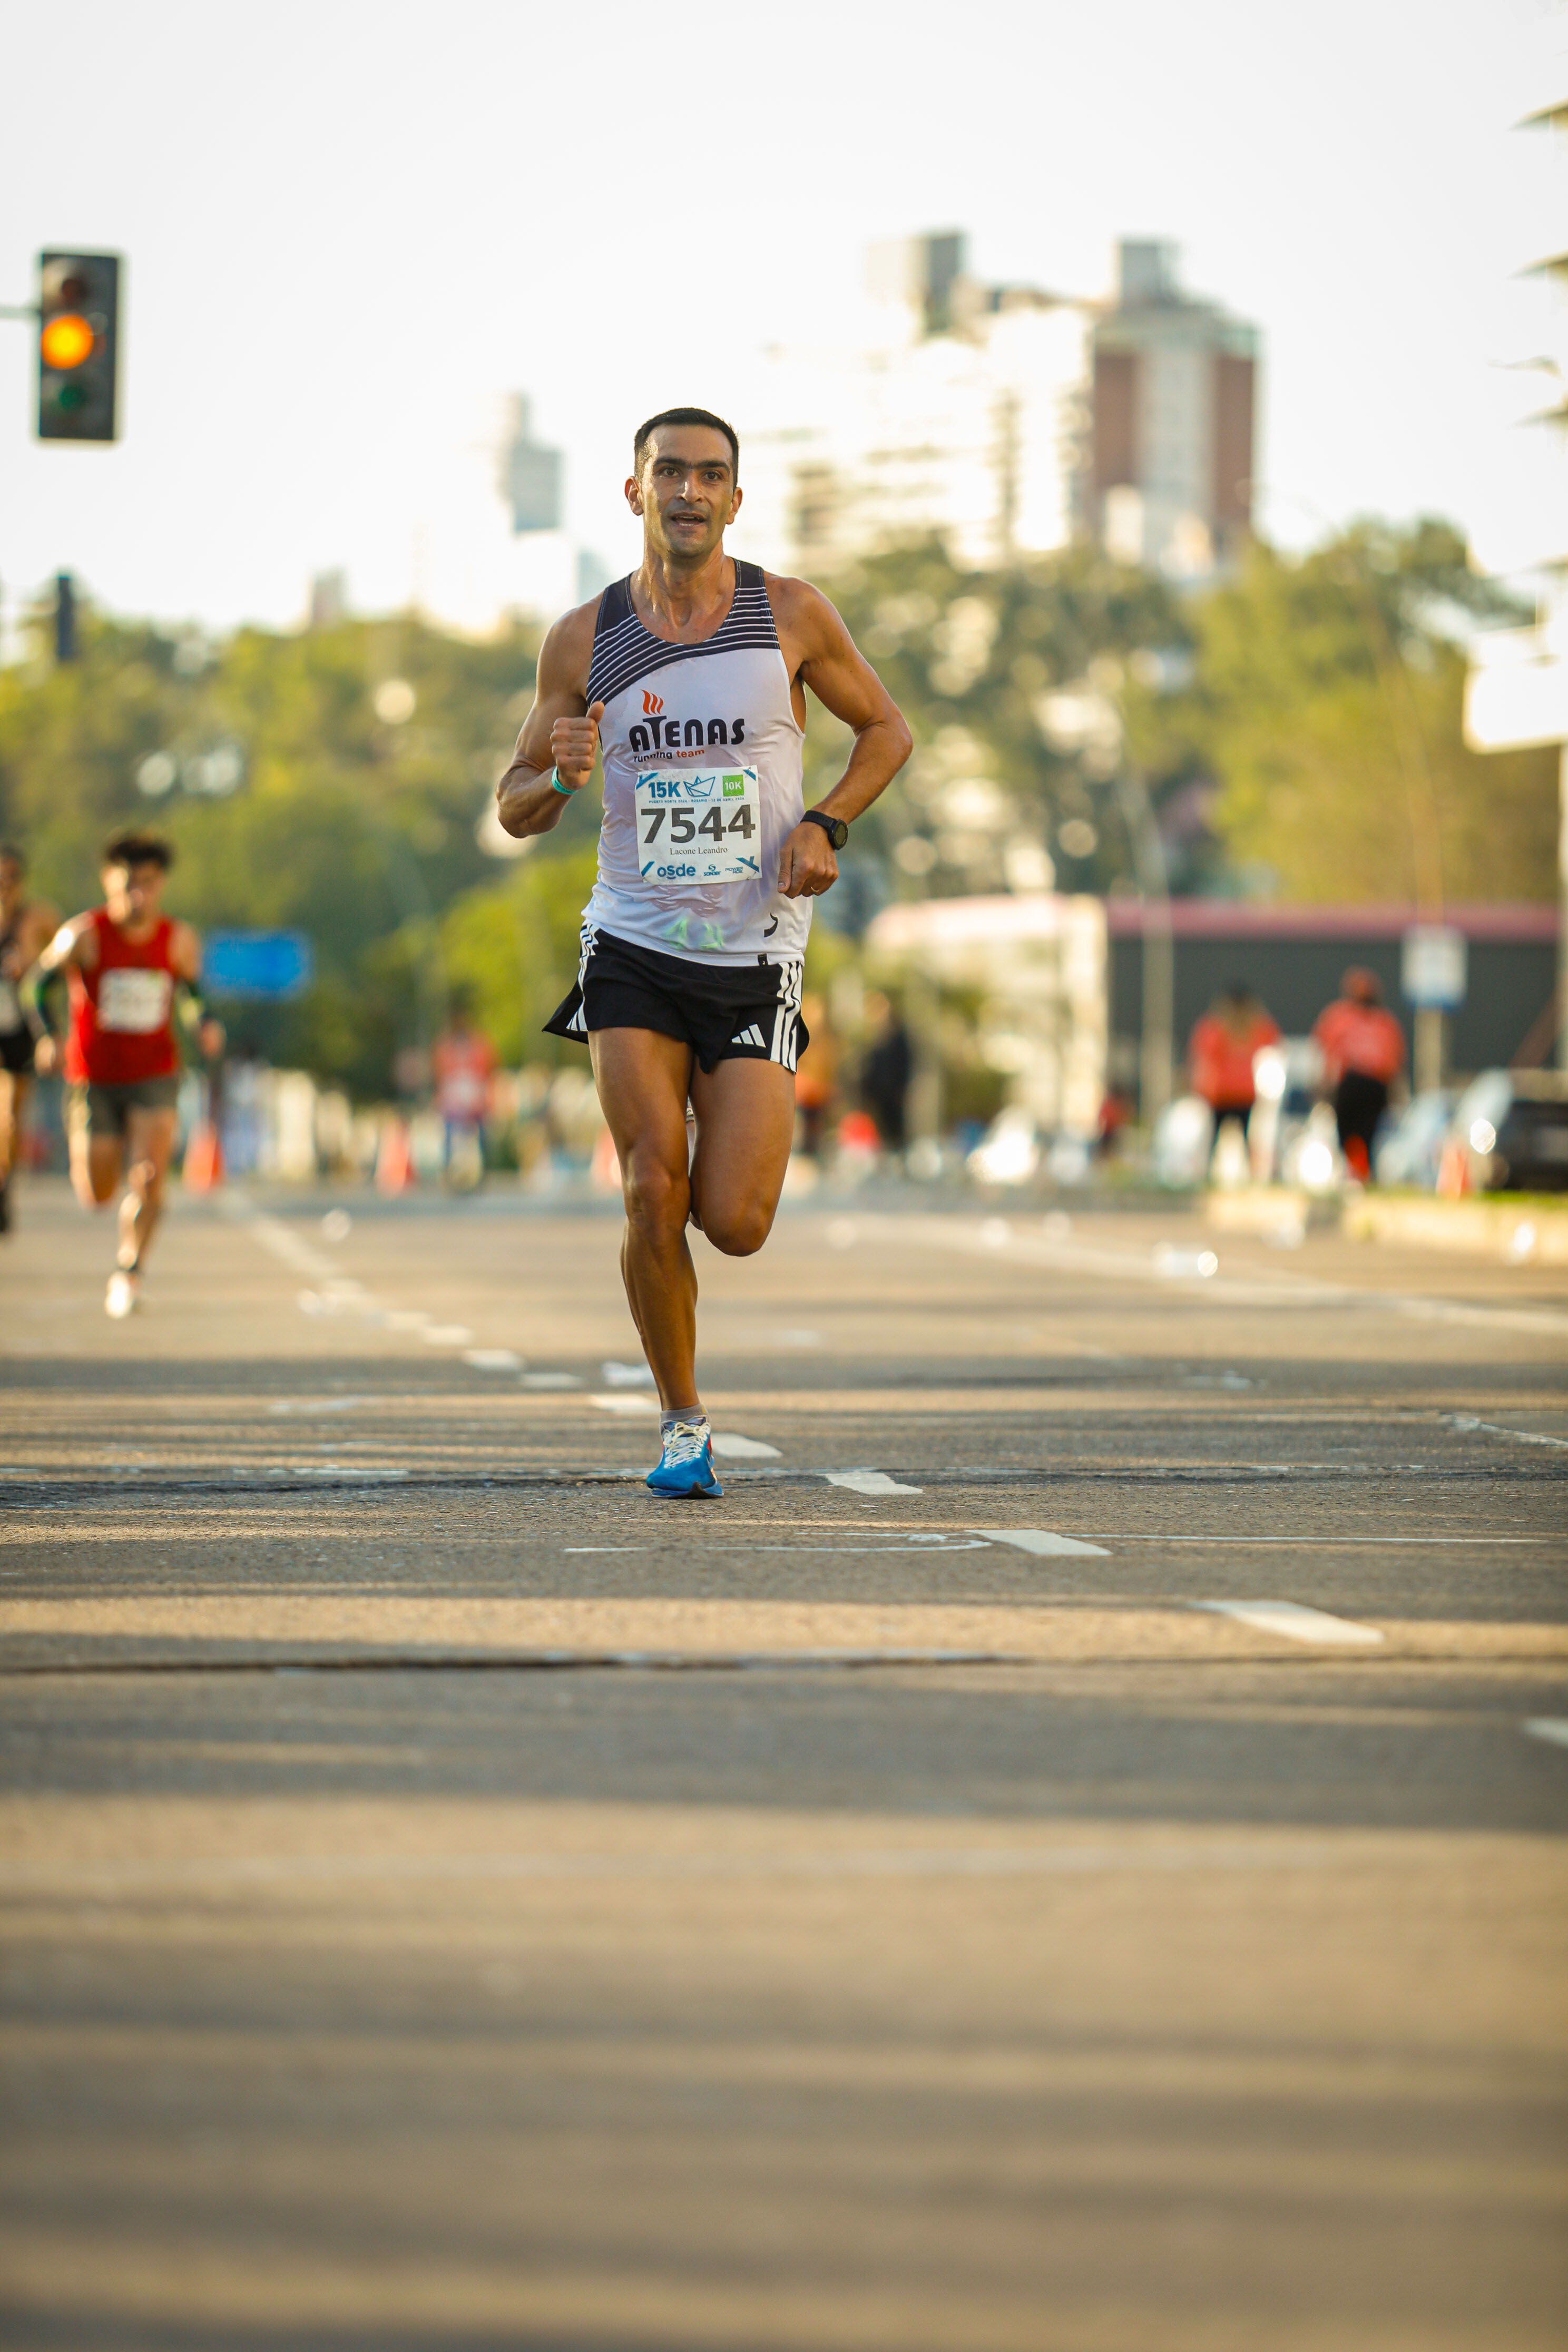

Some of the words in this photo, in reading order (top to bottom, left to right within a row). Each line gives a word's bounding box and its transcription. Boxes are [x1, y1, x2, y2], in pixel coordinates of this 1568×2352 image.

[629, 716, 745, 752] ATENAS
[634, 751, 673, 762] running
[676, 749, 705, 758] team
[648, 781, 681, 798] 15K
[724, 780, 742, 790] 10K
[641, 804, 756, 844] 7544
[656, 863, 696, 878] osde
